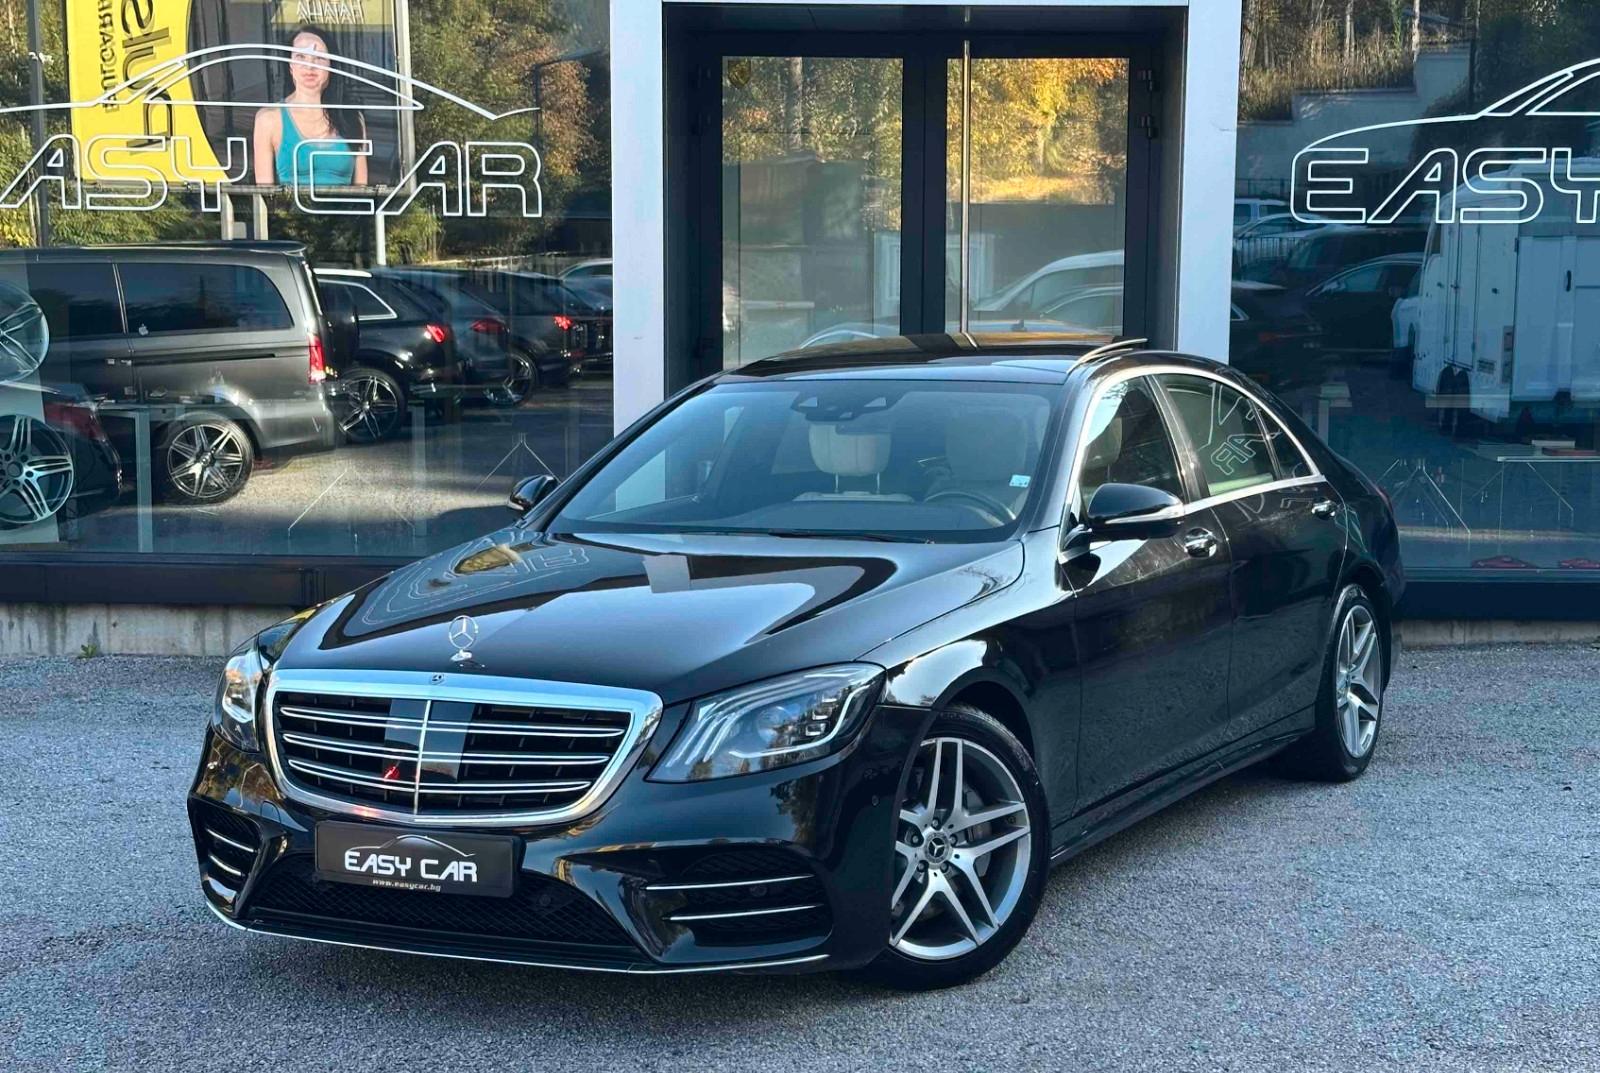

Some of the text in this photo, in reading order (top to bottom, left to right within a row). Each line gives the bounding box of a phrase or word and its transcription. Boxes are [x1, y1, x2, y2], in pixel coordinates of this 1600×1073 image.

[293, 139, 543, 218] CAR
[1290, 147, 1600, 224] EASY
[344, 849, 478, 883] EASY CAR
[372, 879, 442, 893] www.easycar.bg
